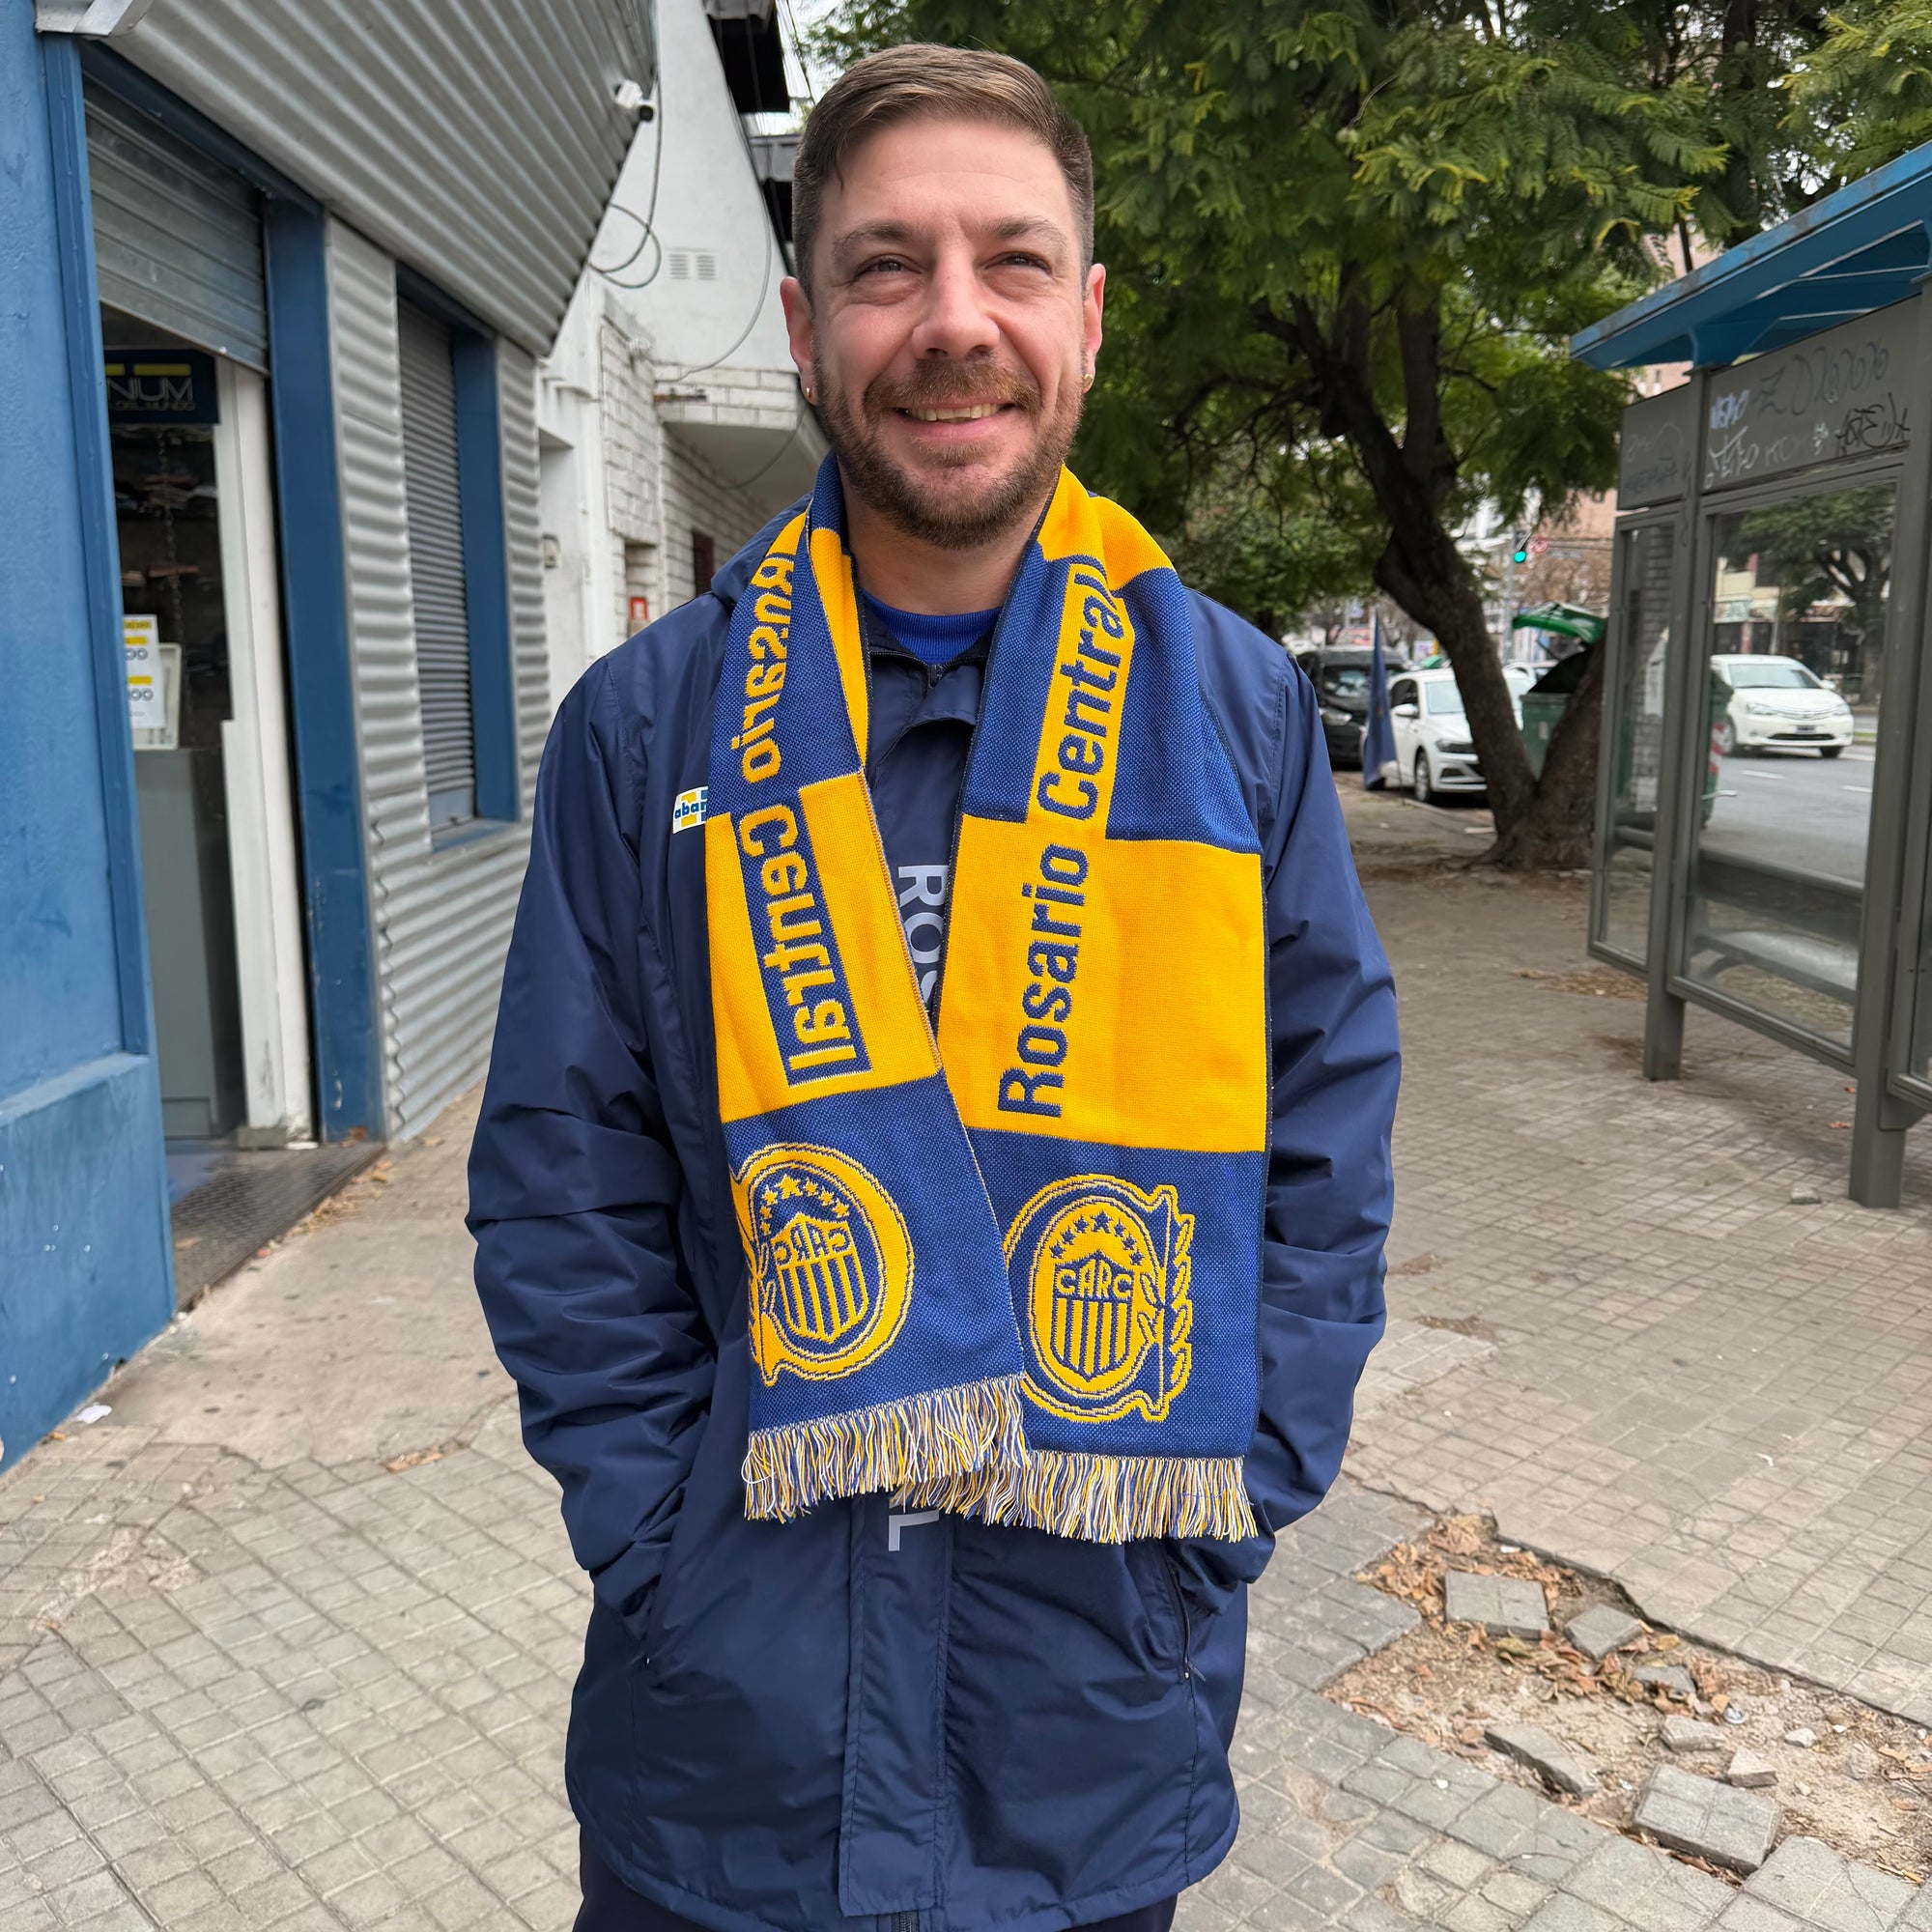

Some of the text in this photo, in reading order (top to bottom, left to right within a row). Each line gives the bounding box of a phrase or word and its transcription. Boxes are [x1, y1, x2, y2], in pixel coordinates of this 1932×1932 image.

[997, 572, 1125, 1119] Rosario Central
[1057, 1259, 1132, 1300] CARC
[889, 1499, 940, 1551] L
